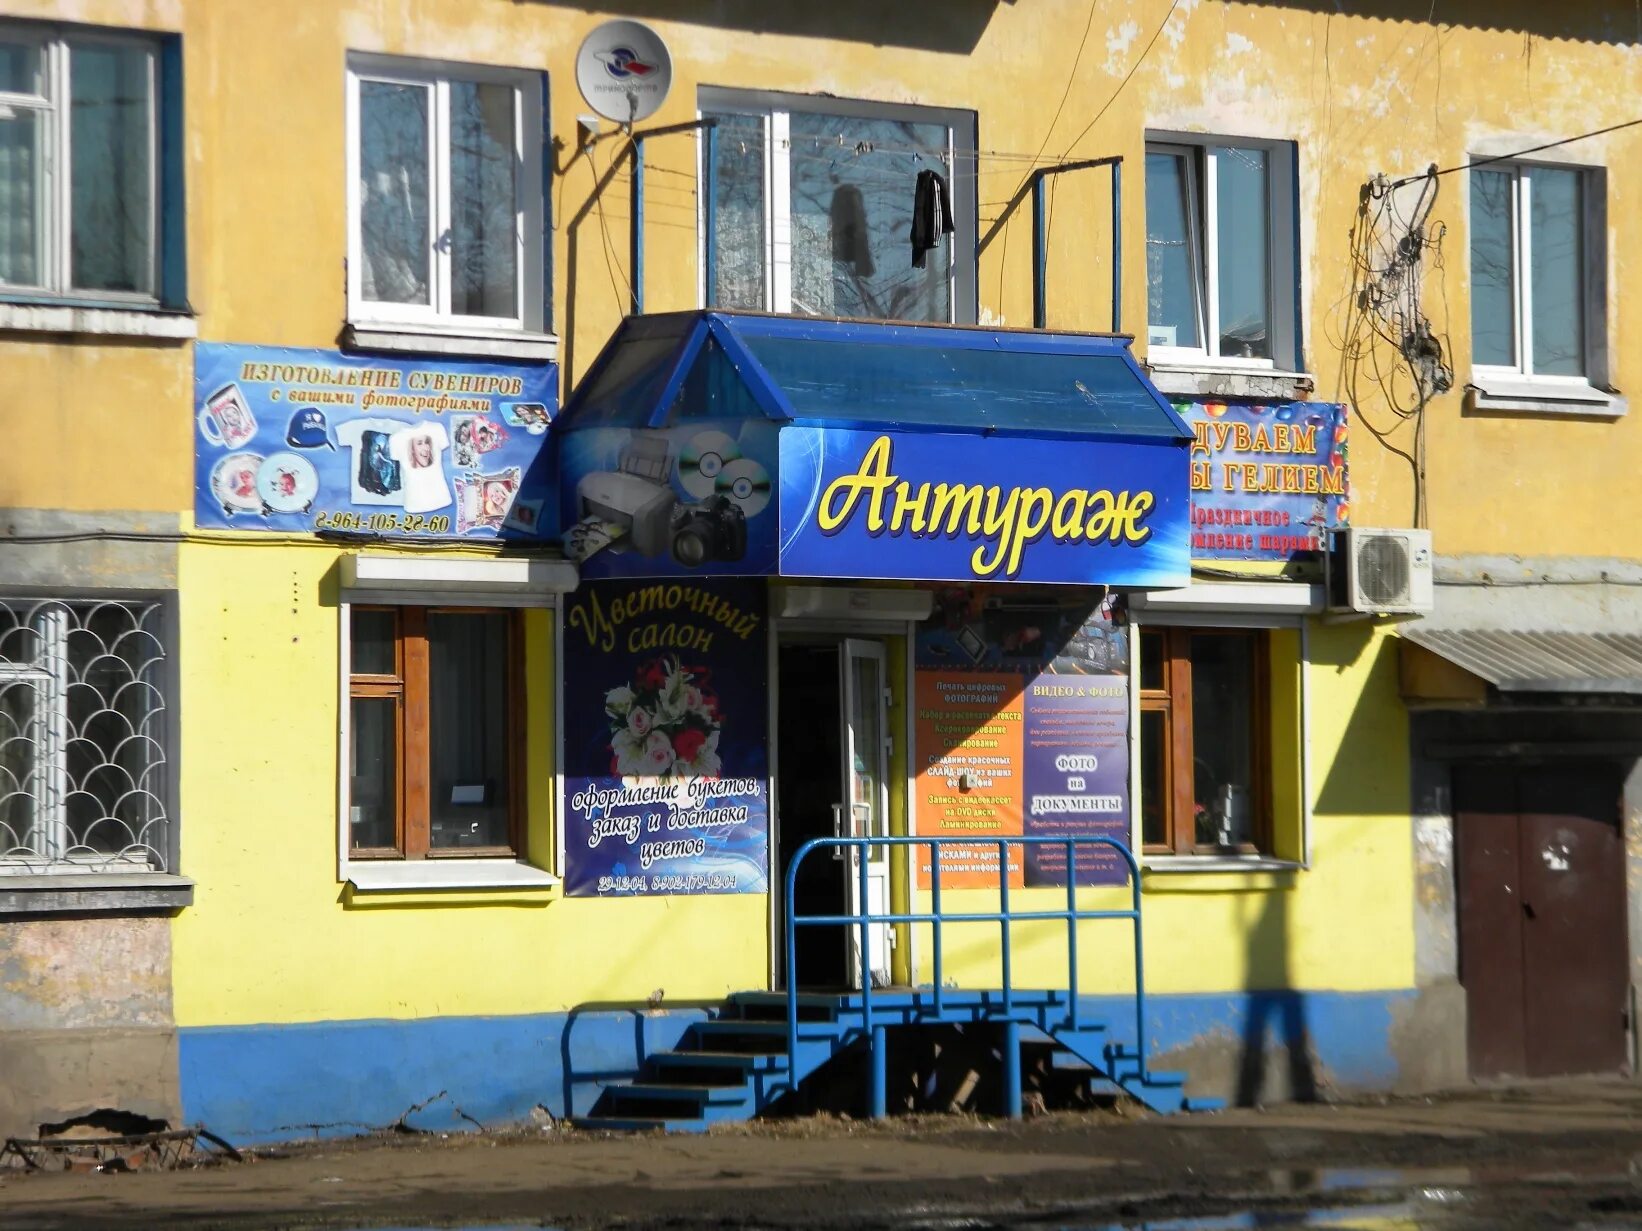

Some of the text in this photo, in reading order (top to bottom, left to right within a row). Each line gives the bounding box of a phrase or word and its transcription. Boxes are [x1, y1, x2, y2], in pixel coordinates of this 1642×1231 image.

[242, 363, 523, 395] ИЗГОТОВЛЕНИЕ СУВЕНИРОВ
[271, 389, 491, 412] с вашими фотографиями
[1223, 464, 1344, 494] ГЕЛИЕМ
[818, 435, 1154, 577] Антураж
[316, 511, 449, 532] 8-964-105-28-60
[1191, 533, 1320, 556] мление шарами
[570, 584, 761, 653] Цветочный
[628, 622, 714, 652] салон
[936, 681, 1007, 693] Печать цифровых
[1033, 685, 1124, 697] ВИДЕО & ФОТО
[944, 694, 998, 704] ФОТОГРАФИЙ
[997, 712, 1022, 721] текста
[928, 755, 1011, 766] Создание красочных
[1057, 755, 1096, 771] ФОТО
[927, 766, 974, 777] СЛАЙД-ШОУ
[987, 769, 1012, 777] ваших
[1069, 779, 1084, 790] на
[572, 772, 761, 819] оформление букетов,
[928, 795, 957, 805] Запись
[964, 796, 1012, 805] видеокассет
[945, 807, 996, 817] на DVD диски
[1033, 798, 1120, 813] ДОКУМЕНТЫ
[588, 804, 747, 848] заказ и доставка
[940, 819, 1002, 830] Ламинирование
[641, 837, 706, 869] цветов
[981, 852, 1011, 861] другии
[922, 863, 1018, 873] ноителями информции
